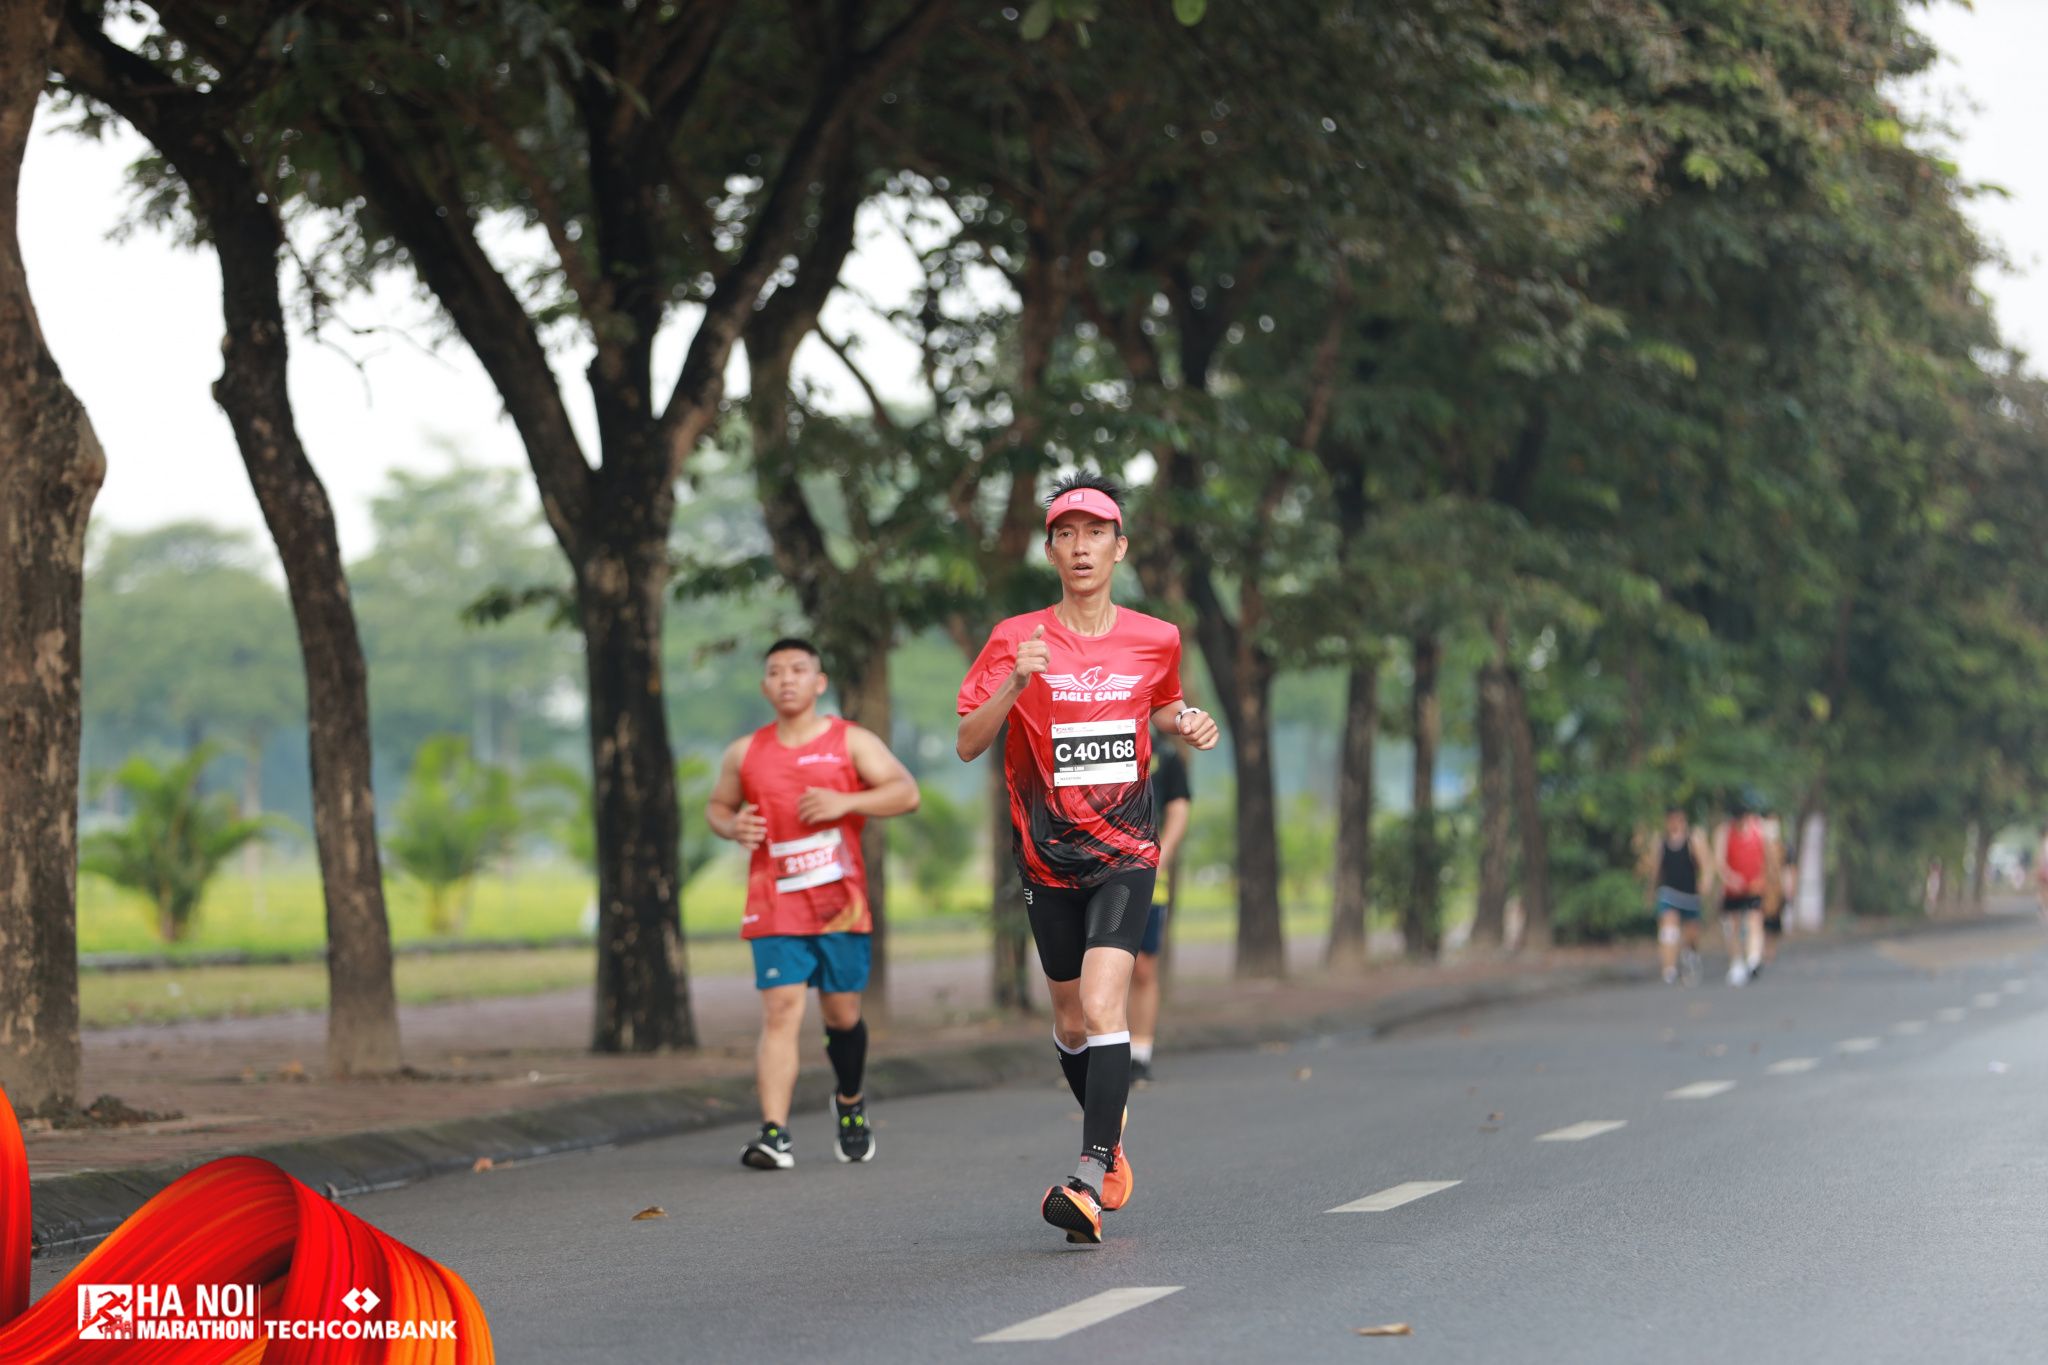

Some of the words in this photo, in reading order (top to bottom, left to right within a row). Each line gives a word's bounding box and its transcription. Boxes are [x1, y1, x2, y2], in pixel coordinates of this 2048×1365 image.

[1052, 690, 1092, 702] EAGLE
[1094, 690, 1131, 701] CAMP
[1055, 739, 1135, 763] C40168
